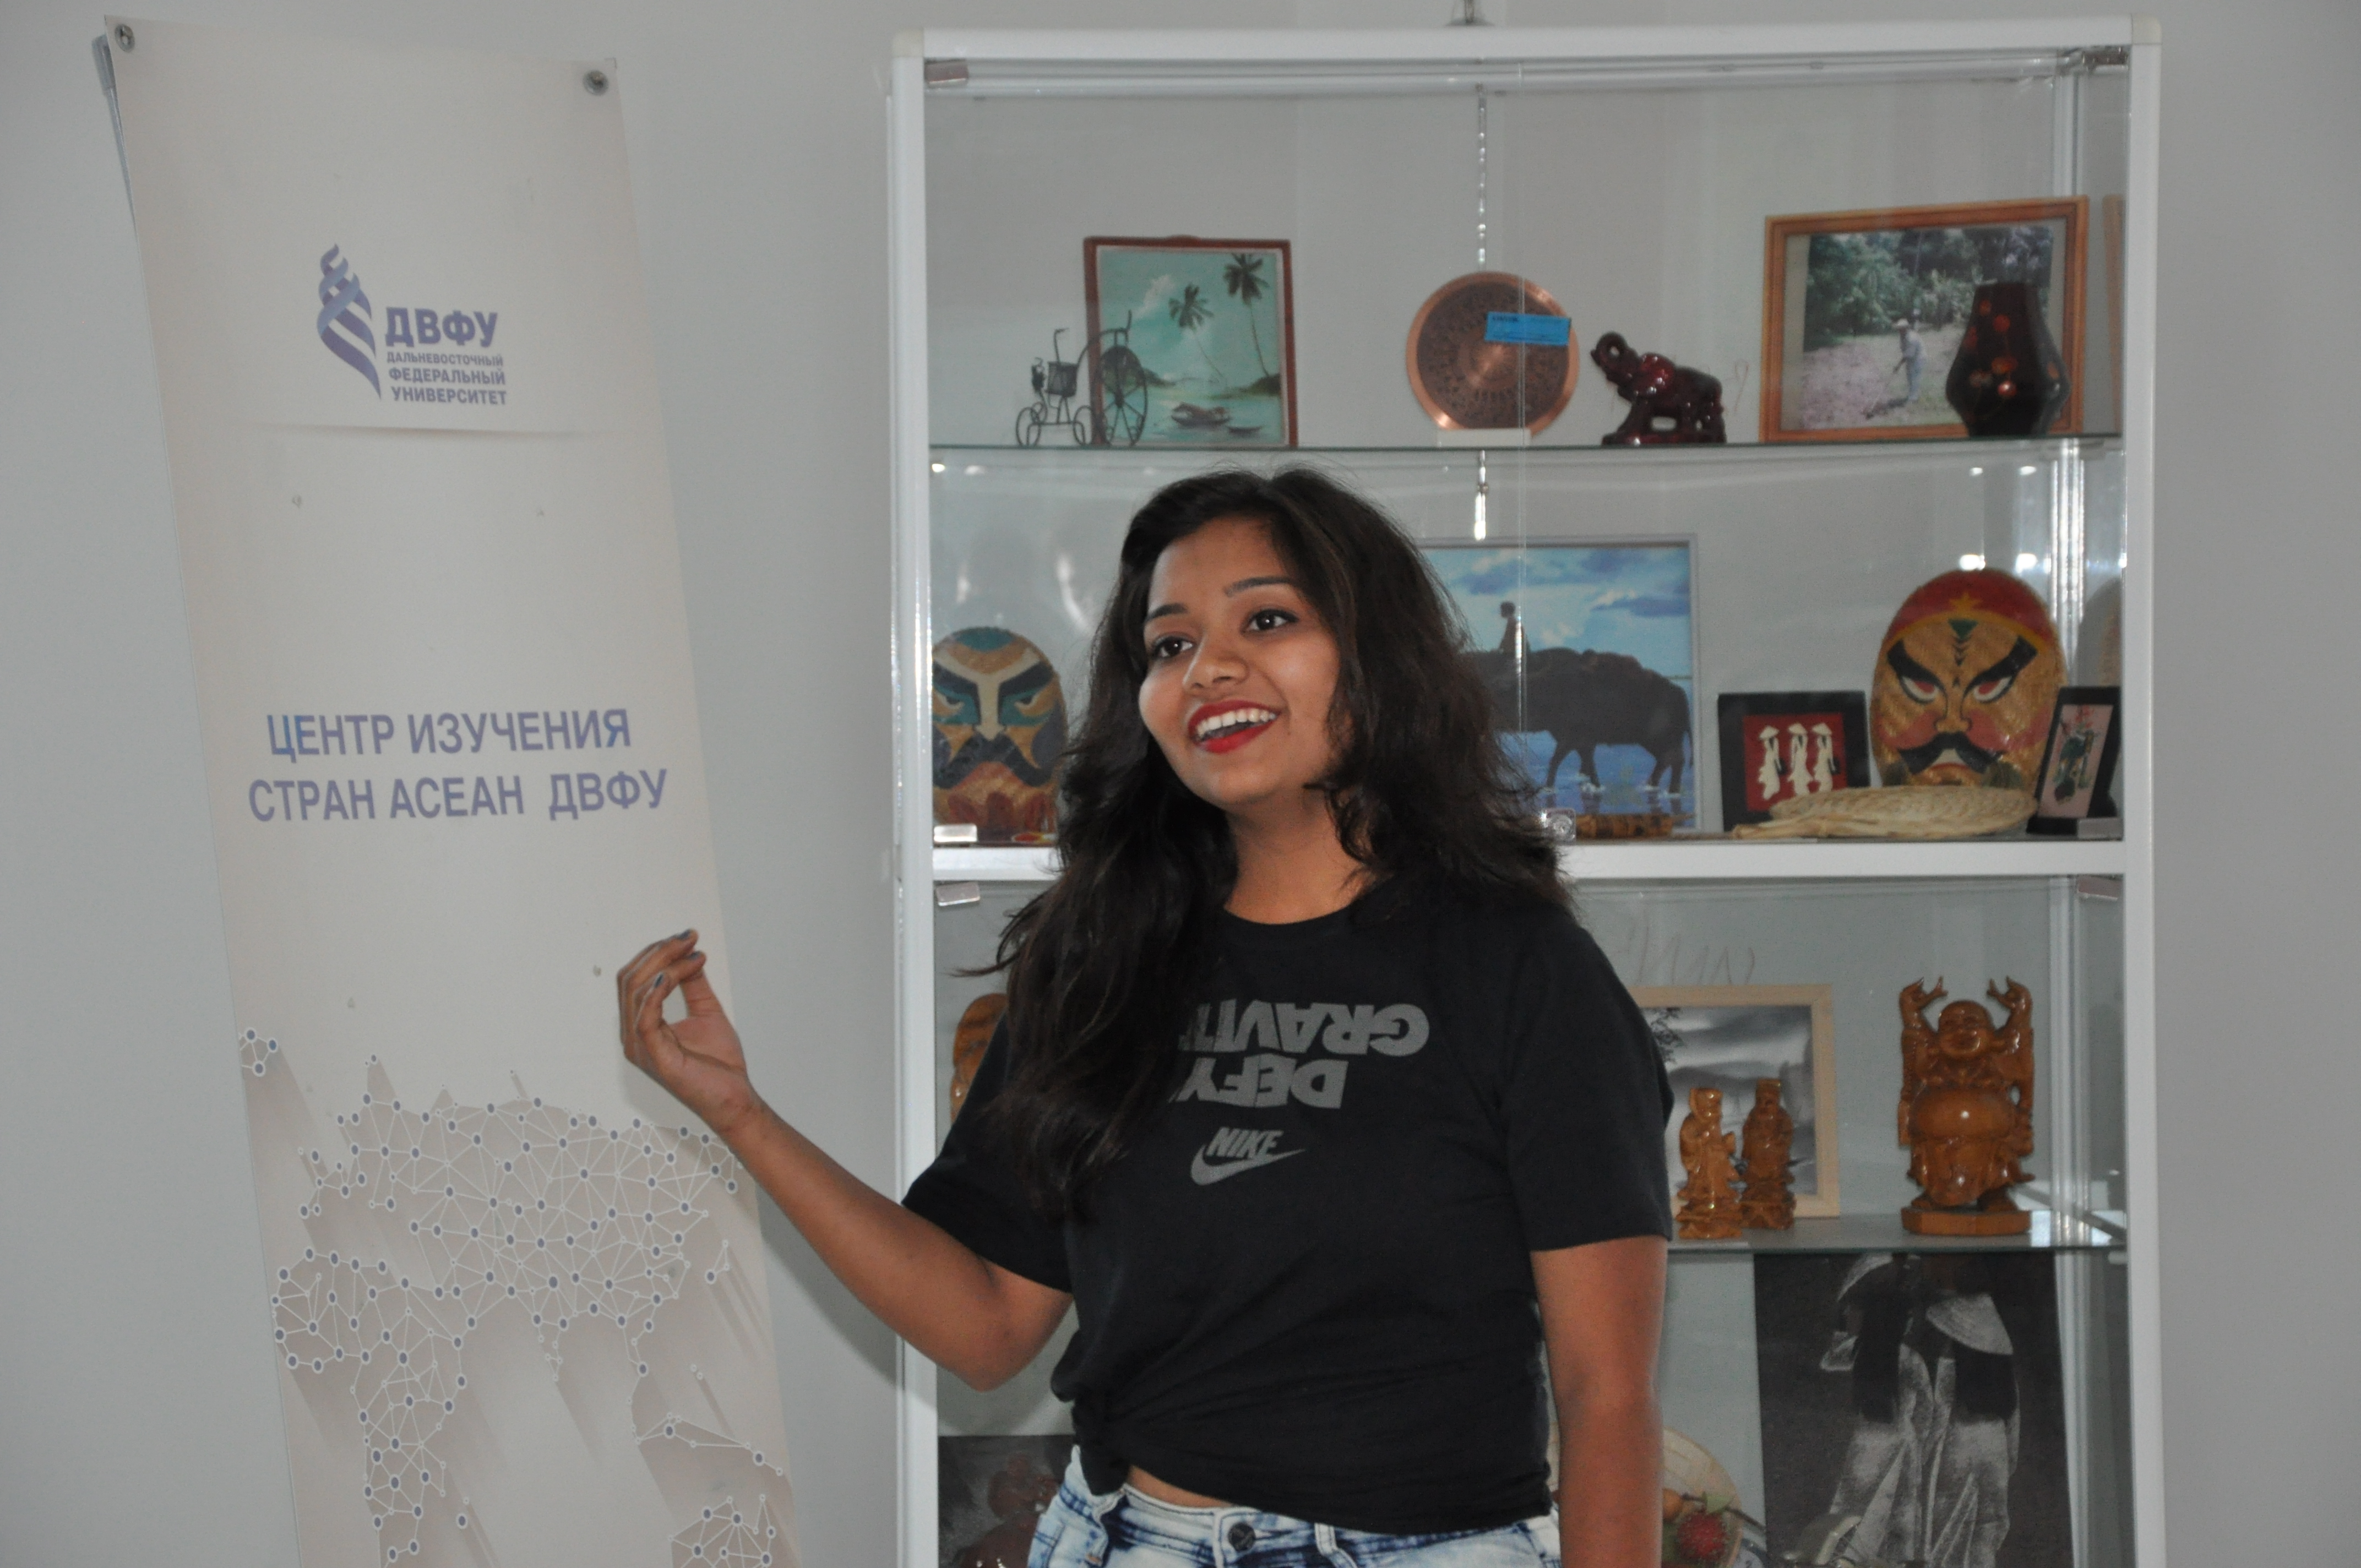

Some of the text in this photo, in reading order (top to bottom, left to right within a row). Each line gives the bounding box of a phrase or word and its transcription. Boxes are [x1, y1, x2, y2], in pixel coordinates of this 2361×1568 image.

[385, 307, 498, 348] ДВФУ
[387, 352, 504, 366] ДАЛЬНЕВОСТОЧНЫЙ
[389, 367, 505, 385] ФЕДЕРАЛЬНЫЙ
[390, 386, 507, 405] УНИВЕРСИТЕТ
[266, 708, 632, 764] ЦЕНТР ИЗУЧЕНИЯ
[248, 769, 668, 823] СТРАН АСЕАН ДВФУ
[1177, 998, 1430, 1057] GRAVIT
[1167, 1052, 1350, 1109] DEFY
[1206, 1126, 1285, 1157] NIKE
